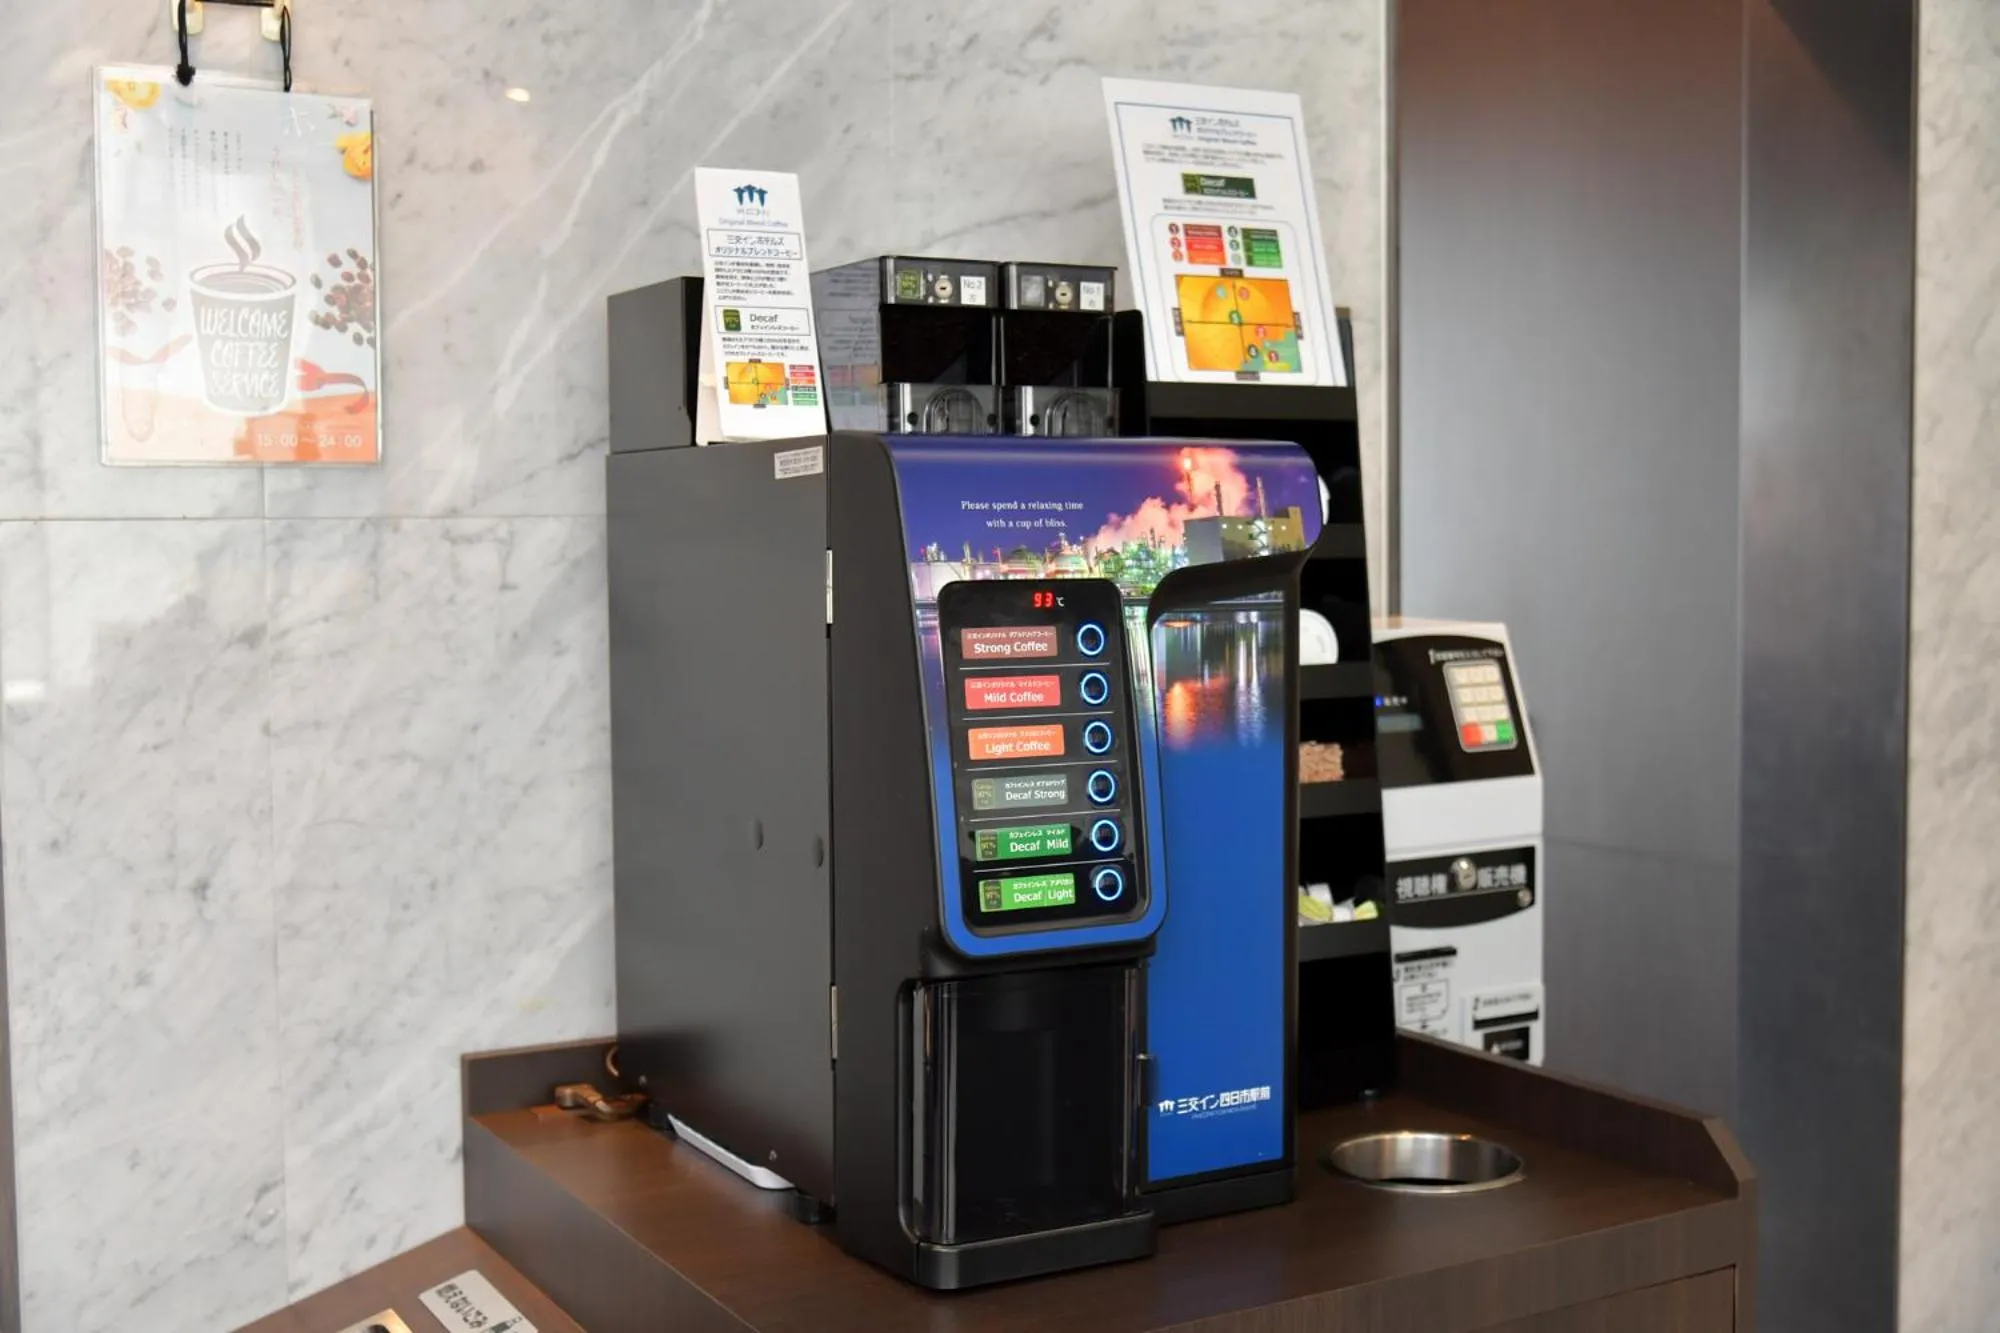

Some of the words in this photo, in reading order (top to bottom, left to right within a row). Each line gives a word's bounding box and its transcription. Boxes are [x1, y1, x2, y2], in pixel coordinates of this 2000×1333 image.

[200, 307, 290, 339] WELCOME
[749, 313, 779, 323] Decaf
[210, 339, 280, 369] COFFEE
[208, 370, 281, 400] SERVICE
[961, 501, 989, 510] Please
[992, 501, 1018, 511] spend
[1028, 501, 1063, 511] relaxing
[1065, 501, 1083, 510] time
[985, 519, 1006, 528] with
[1016, 521, 1032, 530] cup
[1034, 519, 1043, 528] of
[1045, 519, 1067, 528] bliss.
[1033, 592, 1053, 607] 93
[974, 643, 1011, 654] Strong
[1013, 640, 1049, 652] Coffee
[983, 693, 1007, 703] Mild
[1009, 691, 1045, 702] Coffee
[985, 743, 1013, 755] Light
[1016, 741, 1051, 752] Coffee
[1005, 790, 1033, 801] Decaf
[1034, 790, 1065, 800] Strong
[1010, 841, 1040, 852] Decaf
[1046, 838, 1069, 850] Mild
[1013, 892, 1041, 903] Decaf
[1047, 889, 1074, 901] Light
